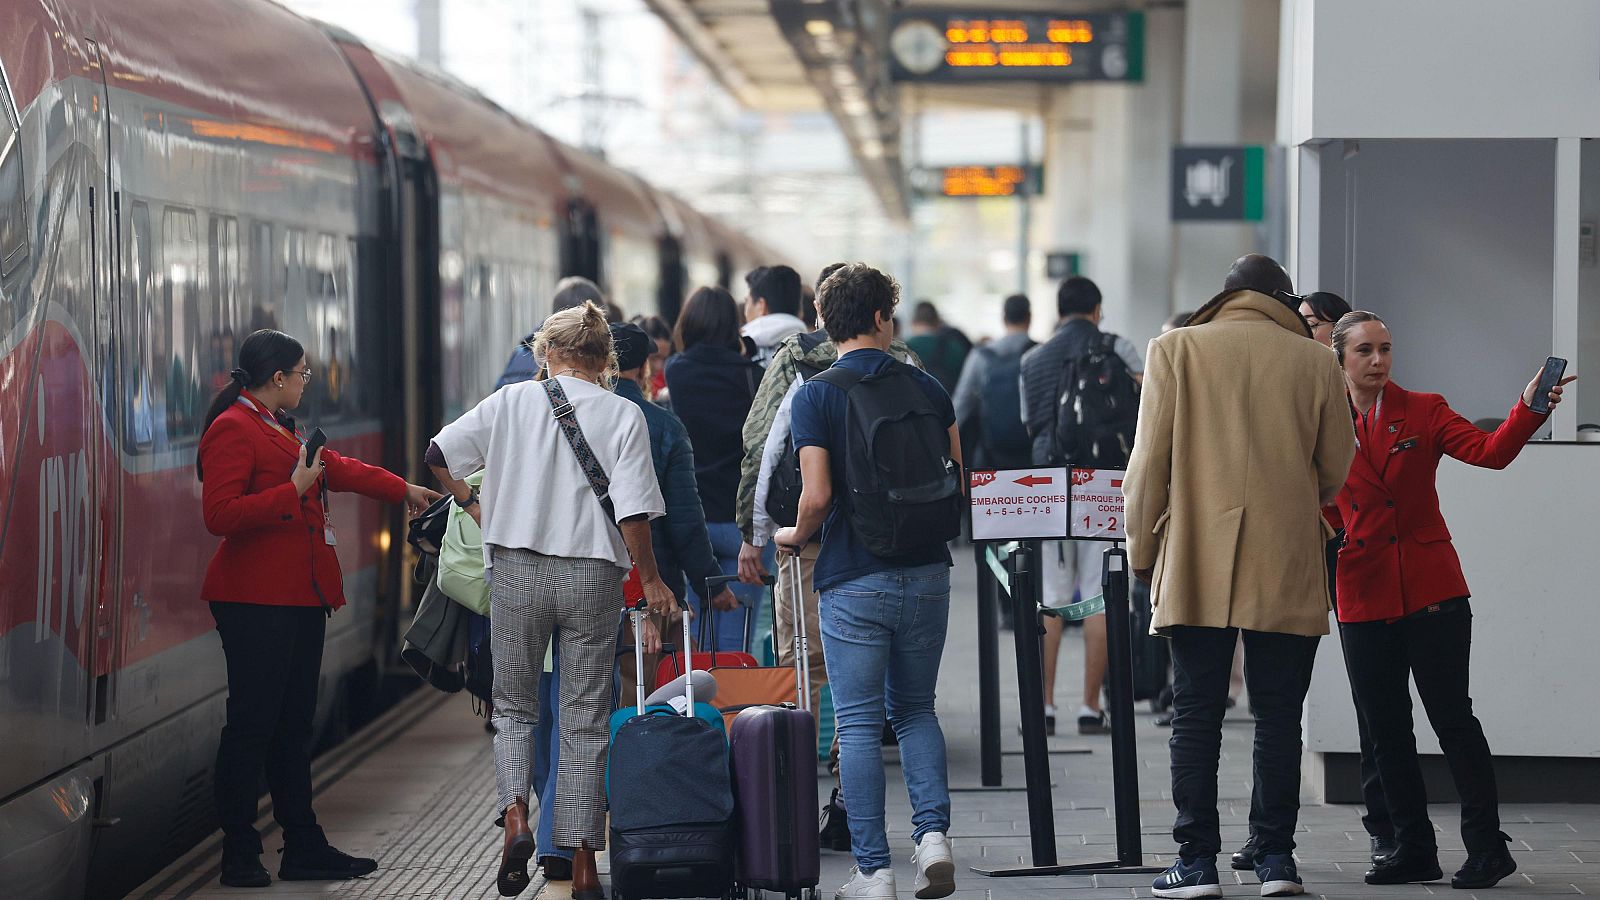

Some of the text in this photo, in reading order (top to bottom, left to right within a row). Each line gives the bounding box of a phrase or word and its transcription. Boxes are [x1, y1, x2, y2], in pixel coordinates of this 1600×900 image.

[971, 471, 993, 483] iryo
[1071, 471, 1089, 482] ryo
[971, 494, 1066, 506] EMBARQUE COCHES
[1098, 504, 1125, 513] COCHE
[35, 373, 90, 708] iryo
